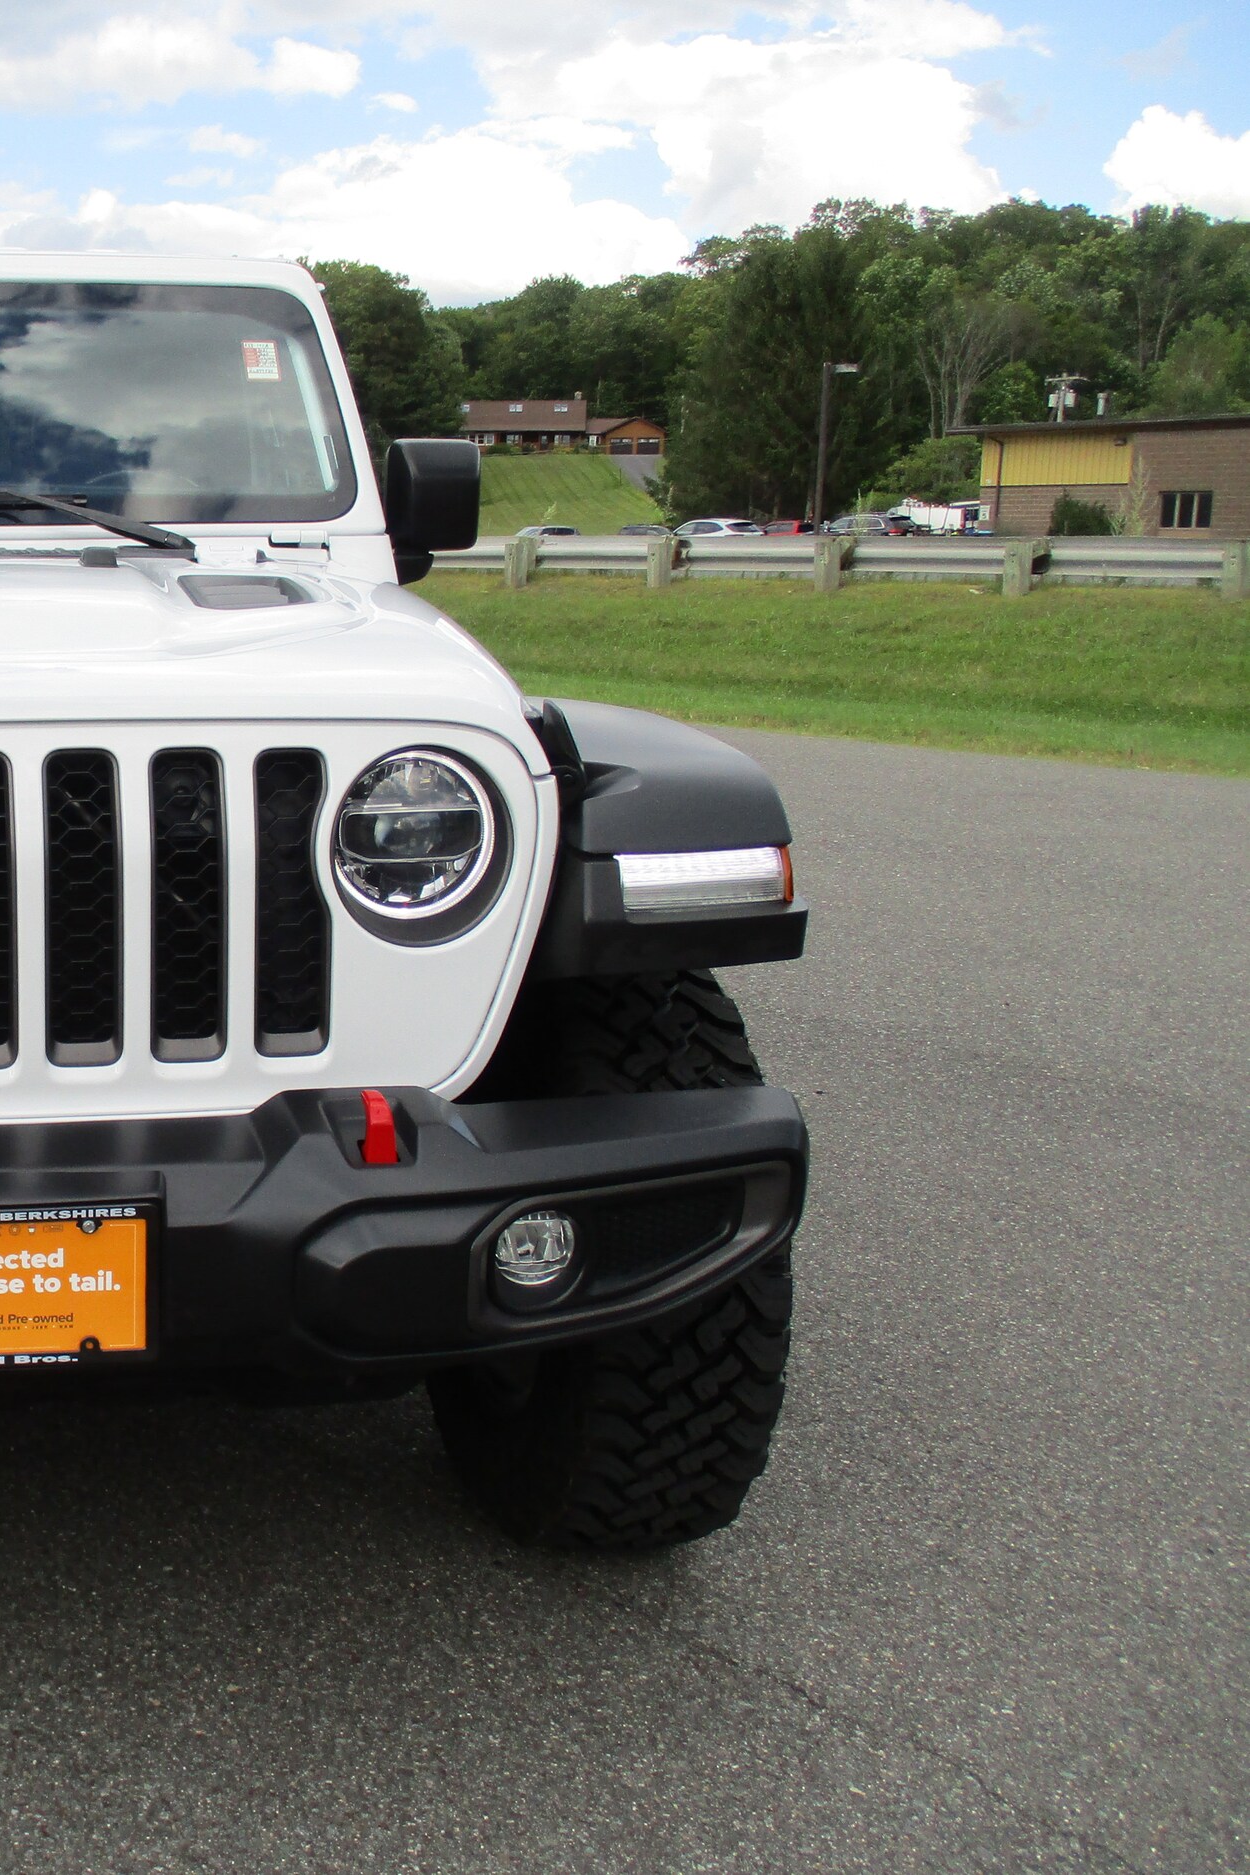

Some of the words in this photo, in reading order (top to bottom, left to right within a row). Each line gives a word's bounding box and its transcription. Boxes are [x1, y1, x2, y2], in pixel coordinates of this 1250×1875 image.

[0, 1207, 137, 1221] BERKSHIRES
[32, 1273, 61, 1293] to
[69, 1270, 121, 1292] tail.
[8, 1312, 74, 1324] Pre-owned
[13, 1353, 79, 1365] Bros.
